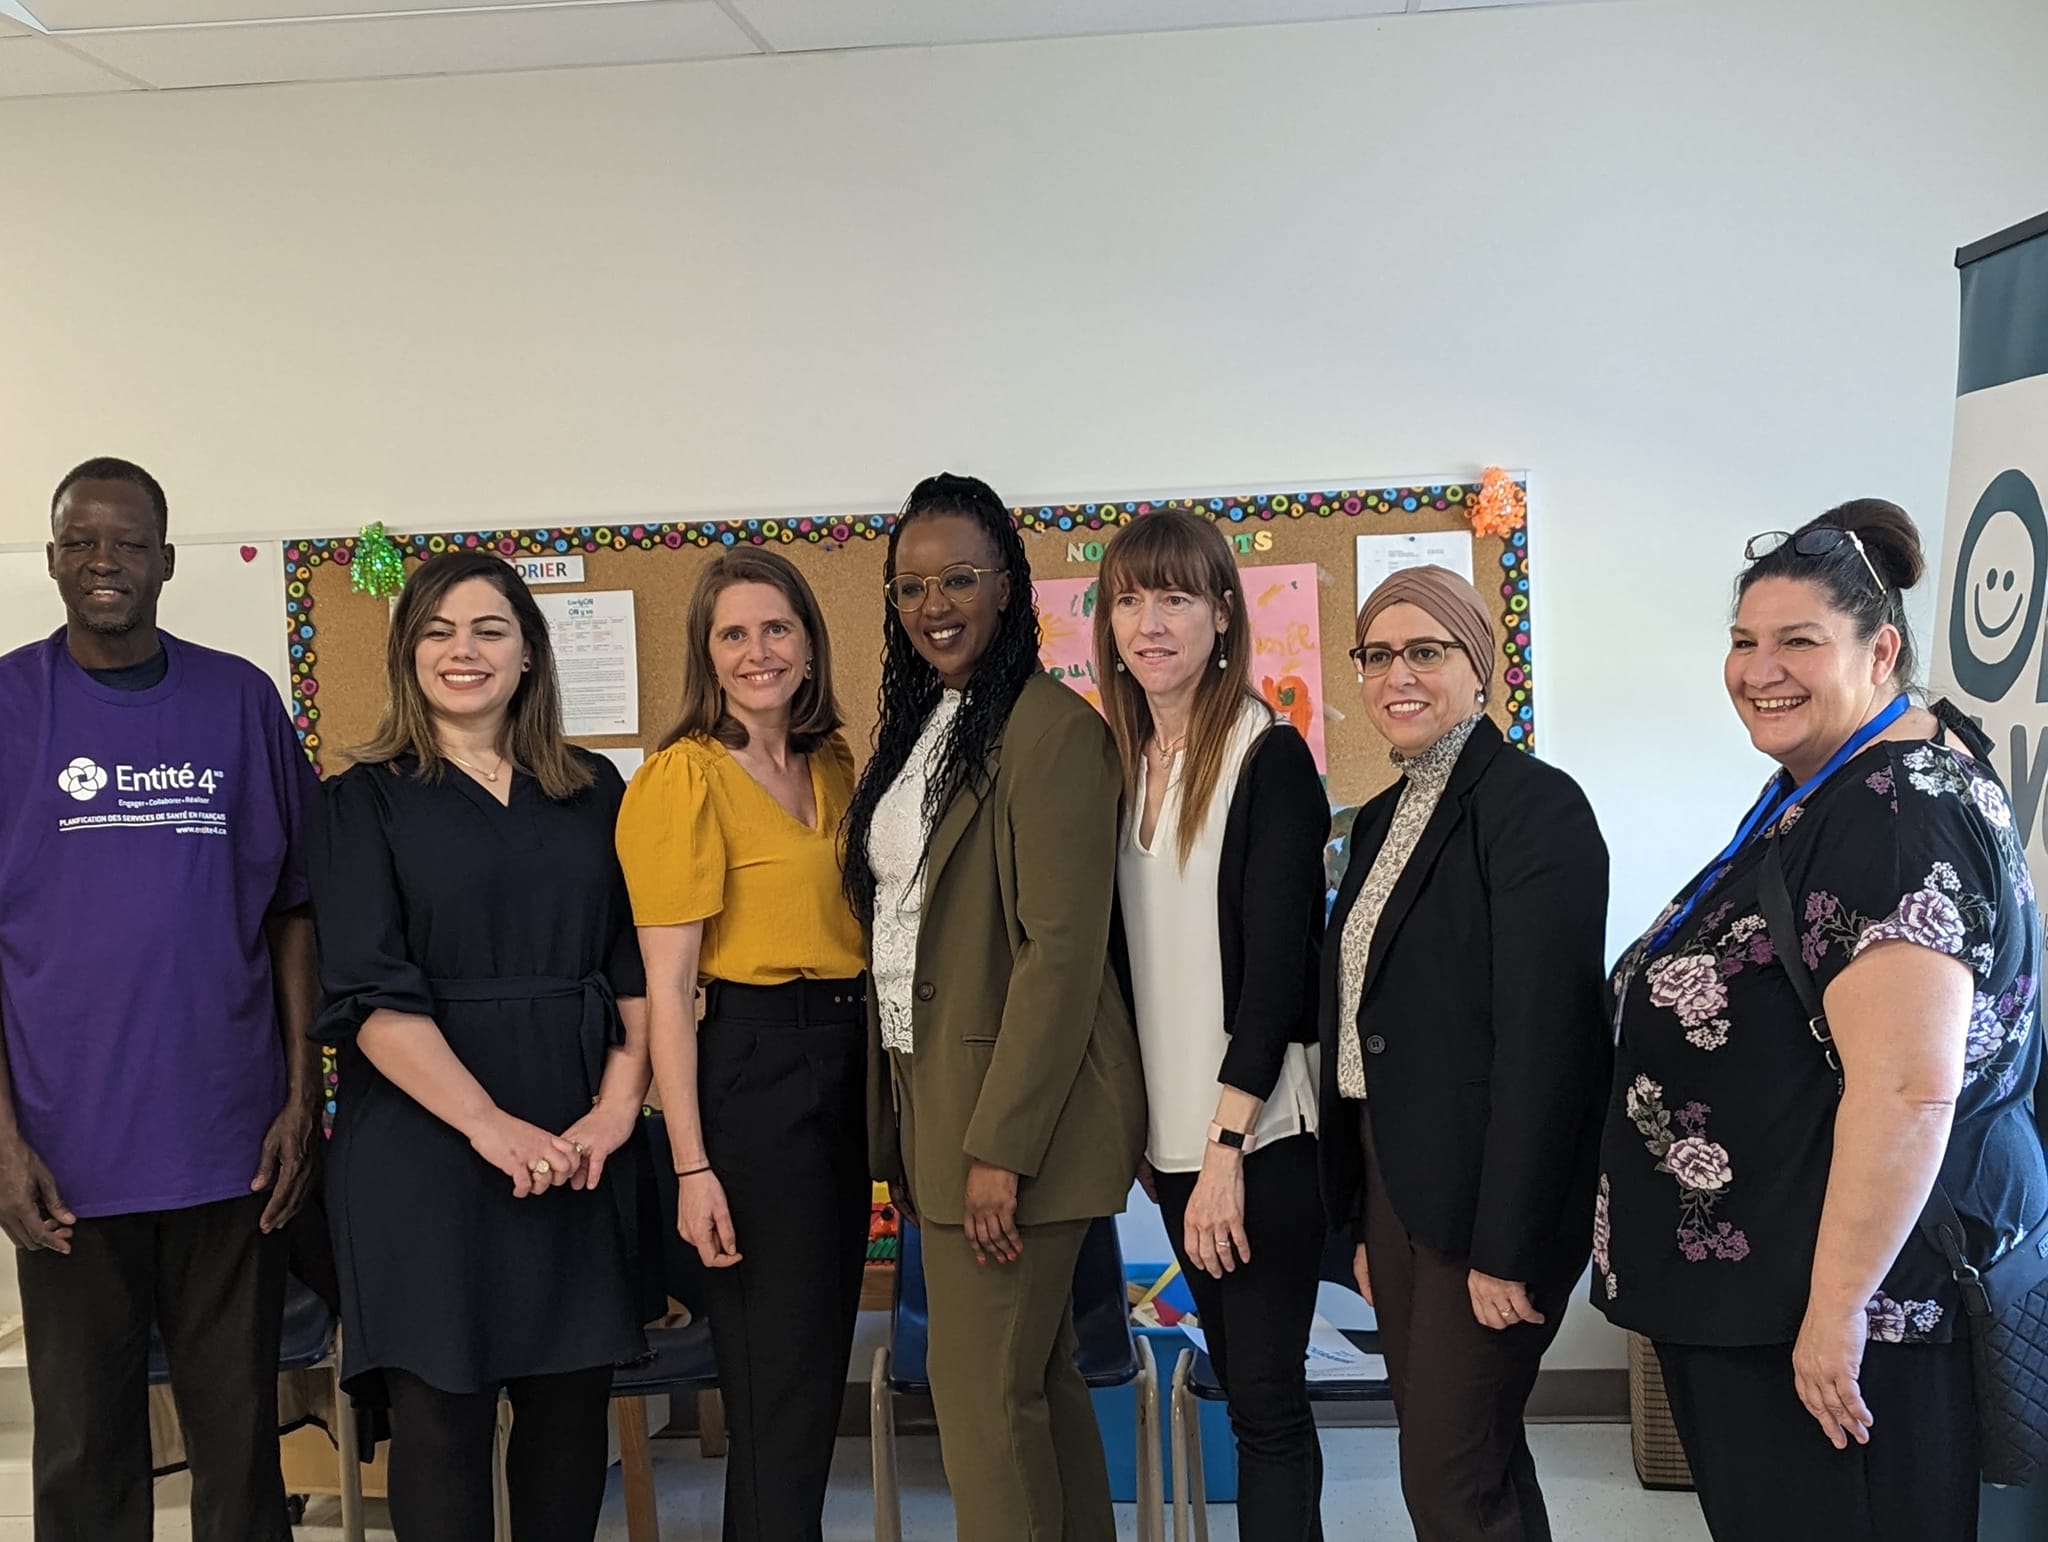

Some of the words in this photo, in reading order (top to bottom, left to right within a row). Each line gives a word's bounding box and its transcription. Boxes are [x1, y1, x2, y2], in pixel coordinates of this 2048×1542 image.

[1066, 541, 1109, 562] NO
[116, 762, 195, 791] Entité
[59, 815, 107, 827] PLANIFICATION
[122, 813, 155, 822] SERVICES
[166, 810, 188, 820] SANTÉ
